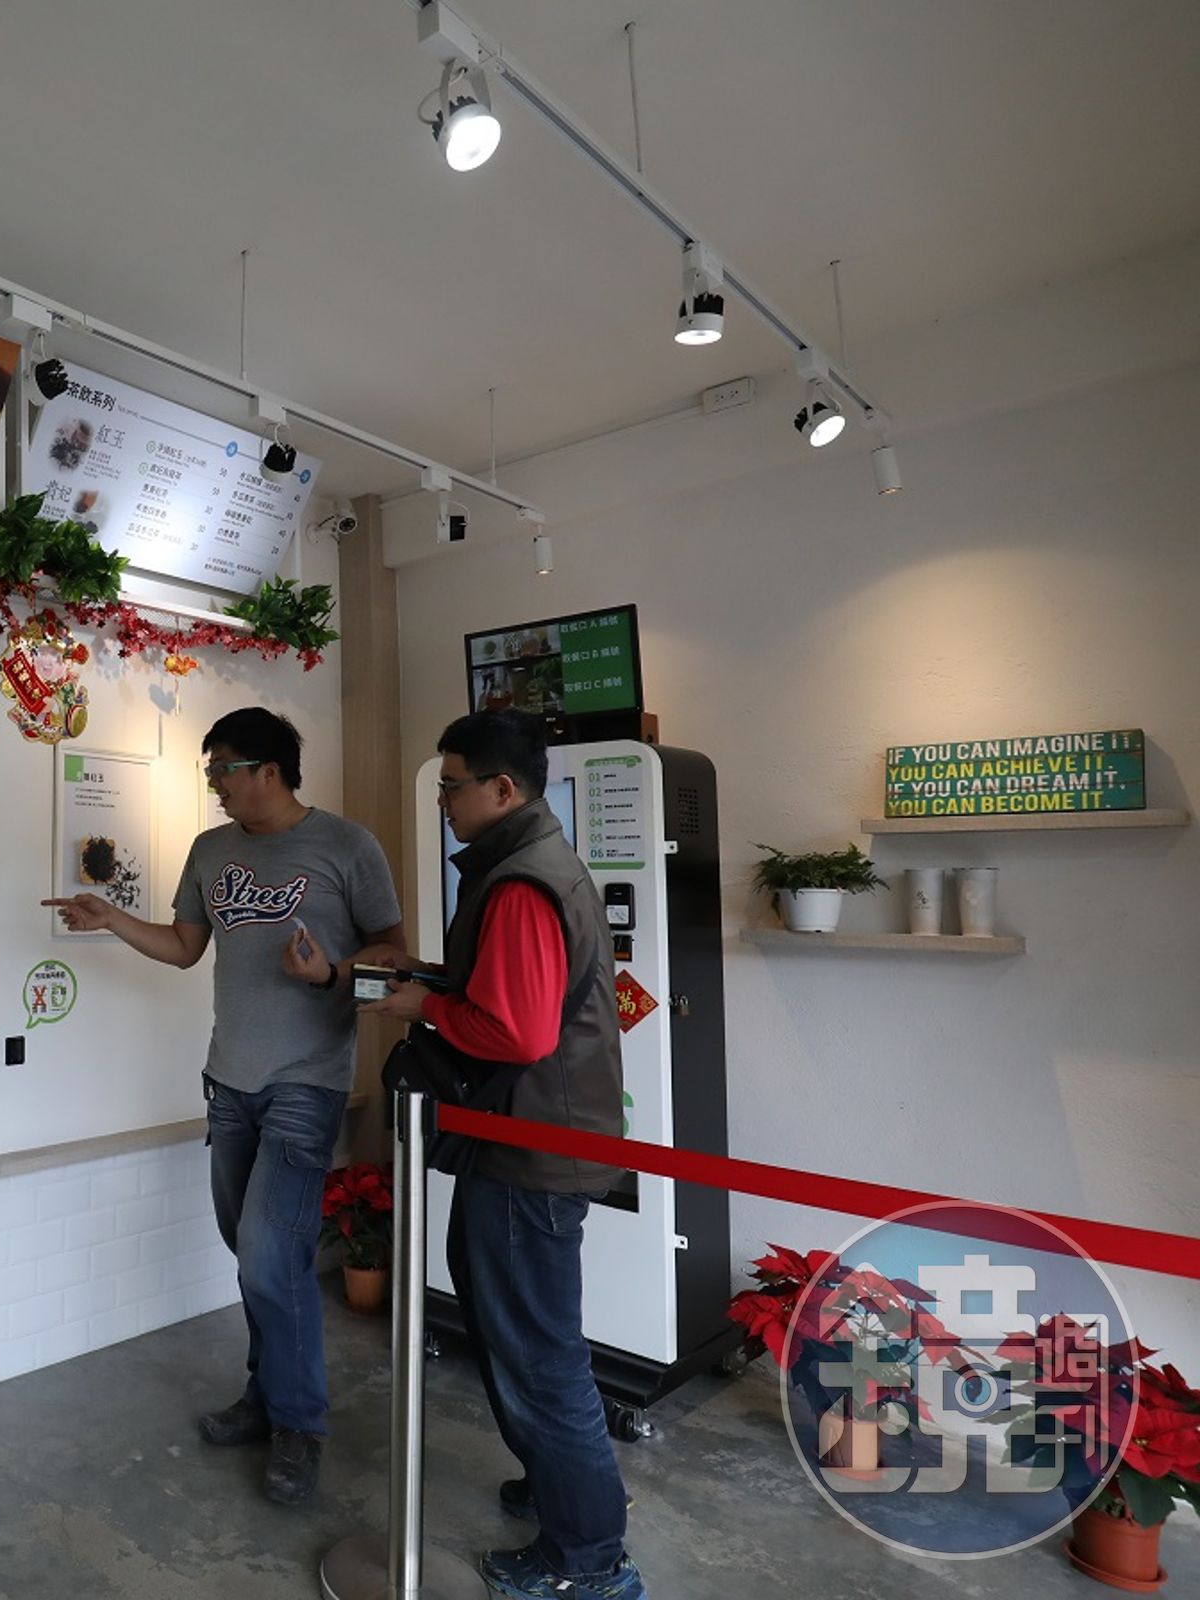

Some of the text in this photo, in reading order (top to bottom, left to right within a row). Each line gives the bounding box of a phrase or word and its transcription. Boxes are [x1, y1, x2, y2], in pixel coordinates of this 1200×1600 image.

[888, 748, 906, 765] IF
[912, 744, 951, 763] YOU
[957, 741, 1000, 760] CAN
[1006, 733, 1104, 756] IMAGINE
[588, 772, 601, 783] 01
[889, 765, 926, 782] YOU
[932, 763, 974, 779] CAN
[981, 755, 1078, 777] ACHIEVE
[588, 788, 602, 798] 02
[888, 783, 905, 798] IF
[911, 780, 951, 798] YOU
[957, 777, 1000, 796] CAN
[1006, 773, 1090, 794] DREAM
[888, 799, 926, 816] YOU
[932, 797, 975, 815] CAN
[981, 793, 1076, 813] BECOME
[211, 864, 308, 909] Street
